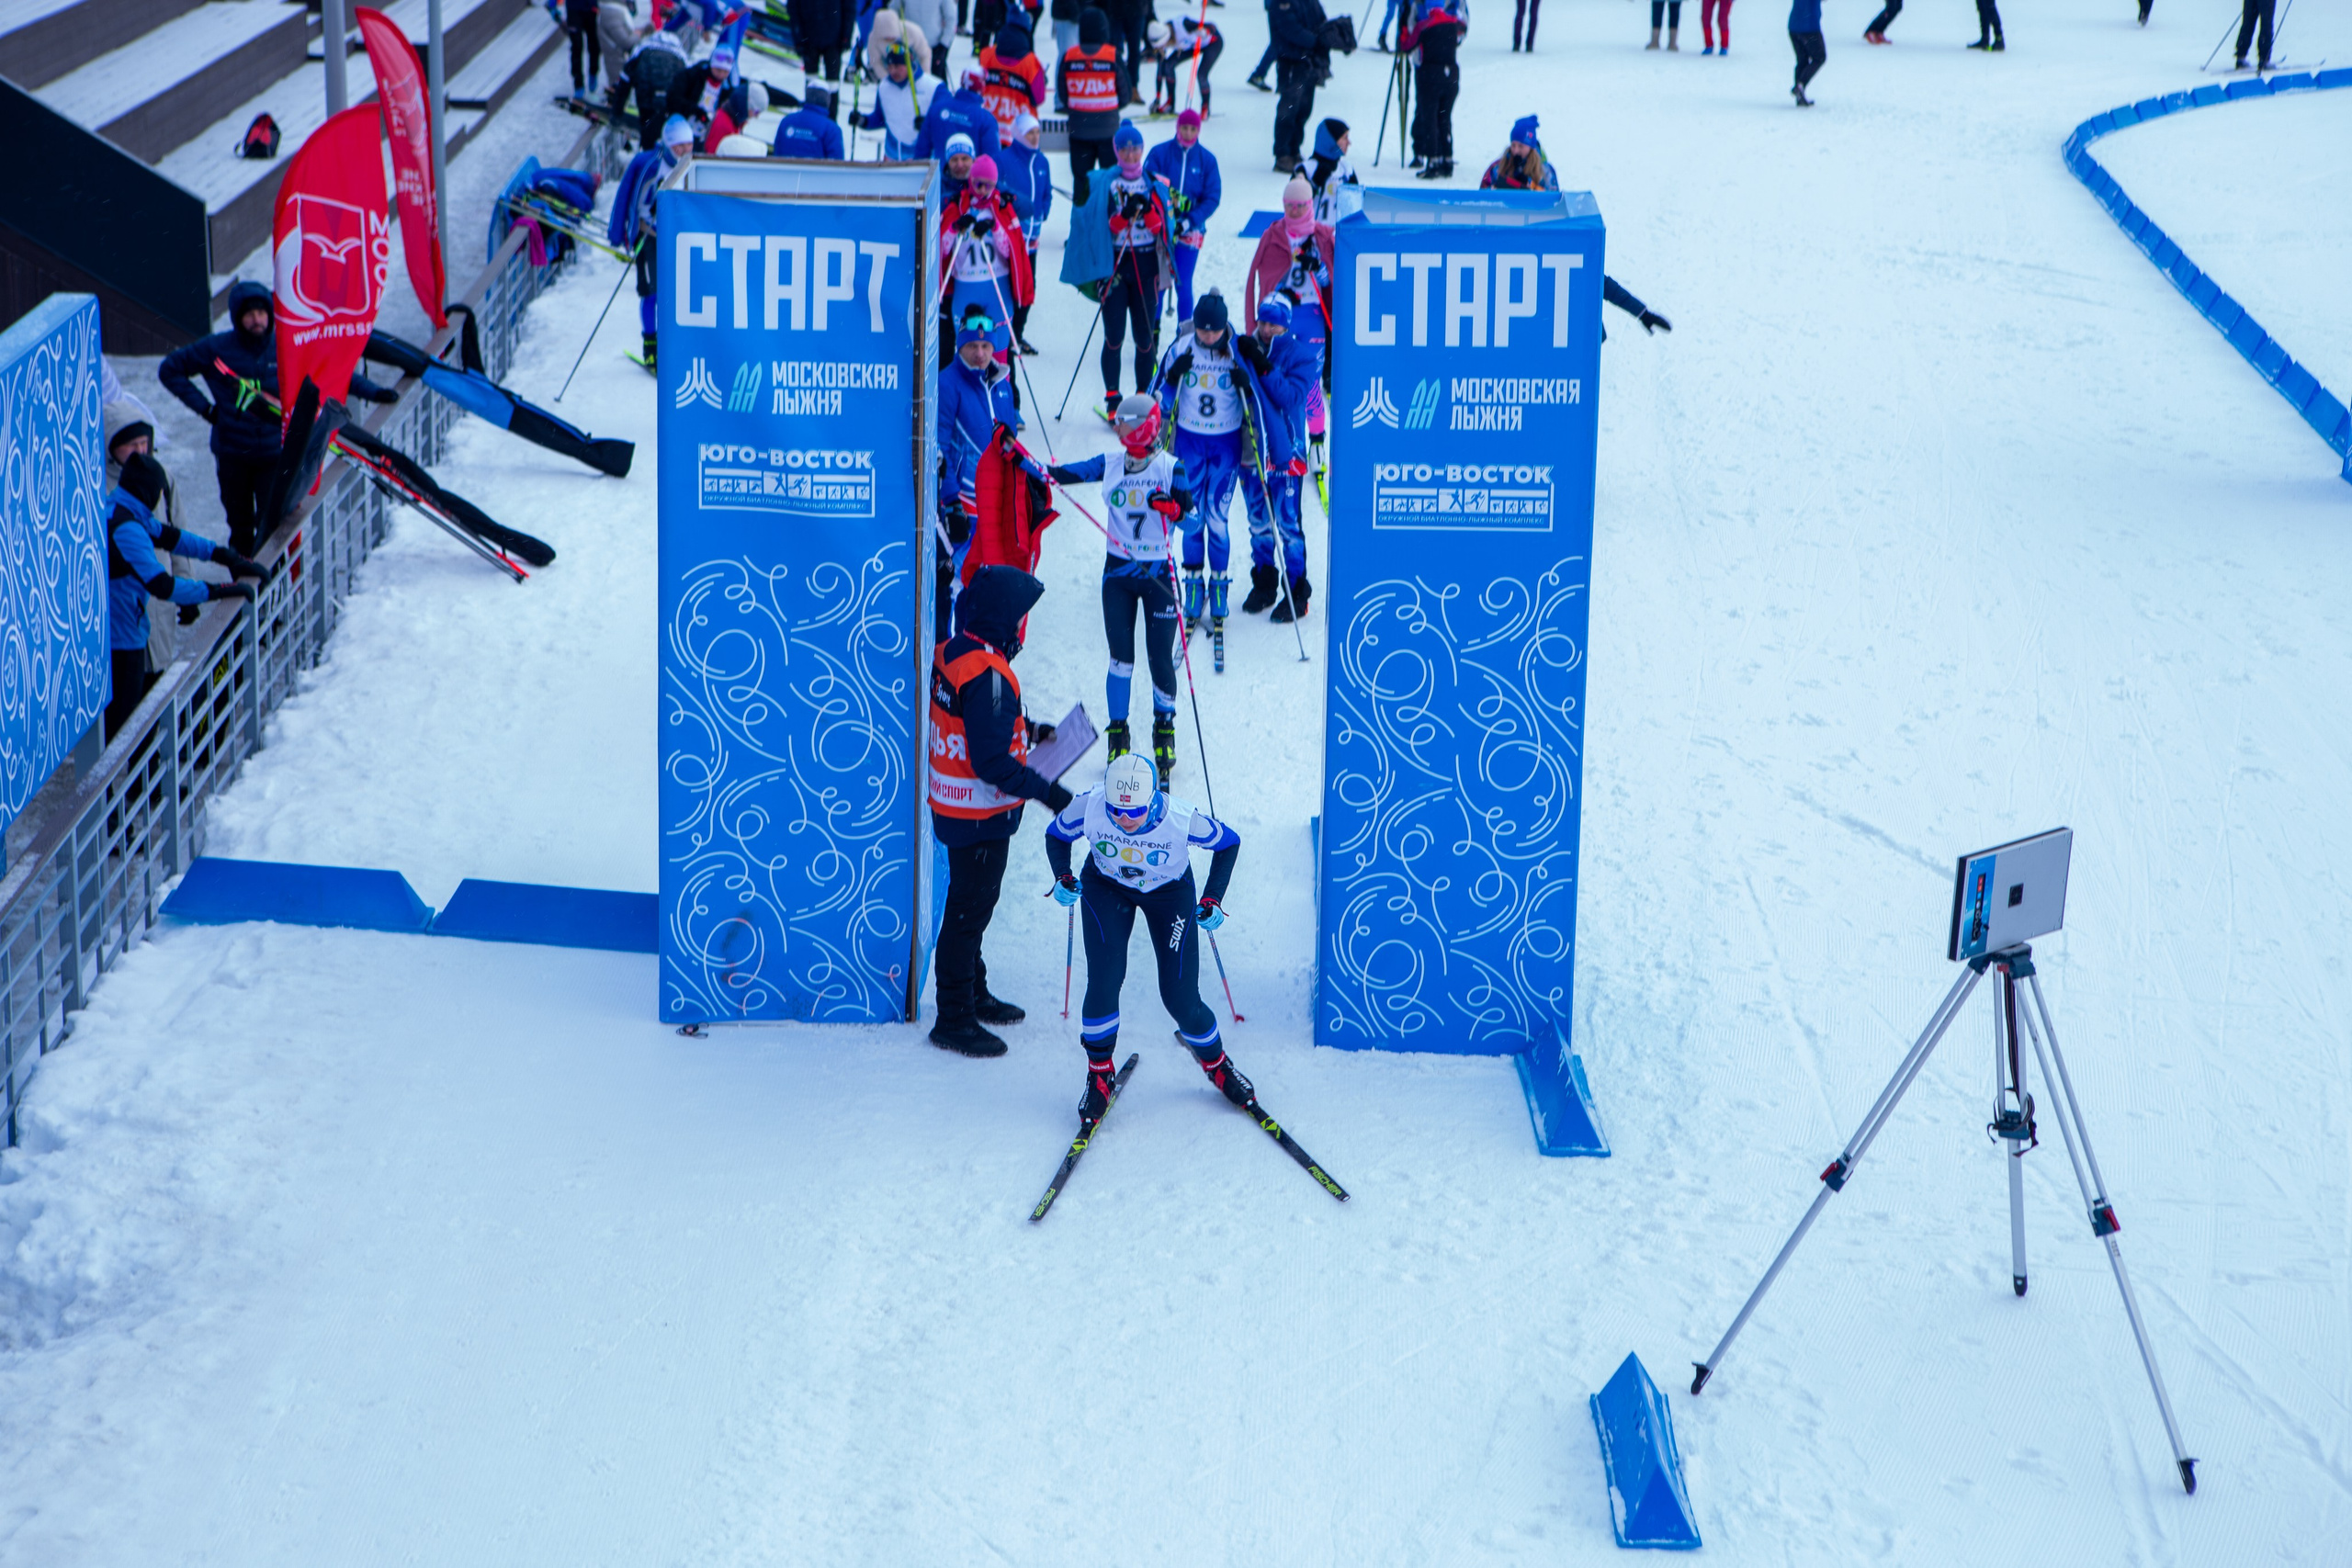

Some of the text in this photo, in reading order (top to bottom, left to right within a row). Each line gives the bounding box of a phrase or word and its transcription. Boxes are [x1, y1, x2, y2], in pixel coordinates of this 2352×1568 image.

[1067, 79, 1115, 96] СУДЬЯ
[967, 243, 995, 266] 10
[676, 231, 900, 333] СТАРТ
[1355, 253, 1584, 348] СТАРТ
[772, 361, 899, 389] МОСКОВСКАЯ
[772, 389, 842, 415] ЛЫЖНЯ
[1451, 378, 1580, 404] МОСКОВСКАЯ
[1198, 394, 1216, 417] 8
[1450, 405, 1522, 431] ЛЫЖНЯ
[699, 444, 873, 469] ЮГО-ВОСТОК
[1374, 463, 1553, 484] ЮГО-ВОСТОК
[1127, 512, 1147, 540] 7
[930, 717, 967, 761] ДЬЯ
[942, 783, 974, 801] СПОРТ
[1116, 776, 1141, 795] DNB
[1307, 1166, 1342, 1197] FISCHER
[1035, 1187, 1057, 1217] FISCHER
